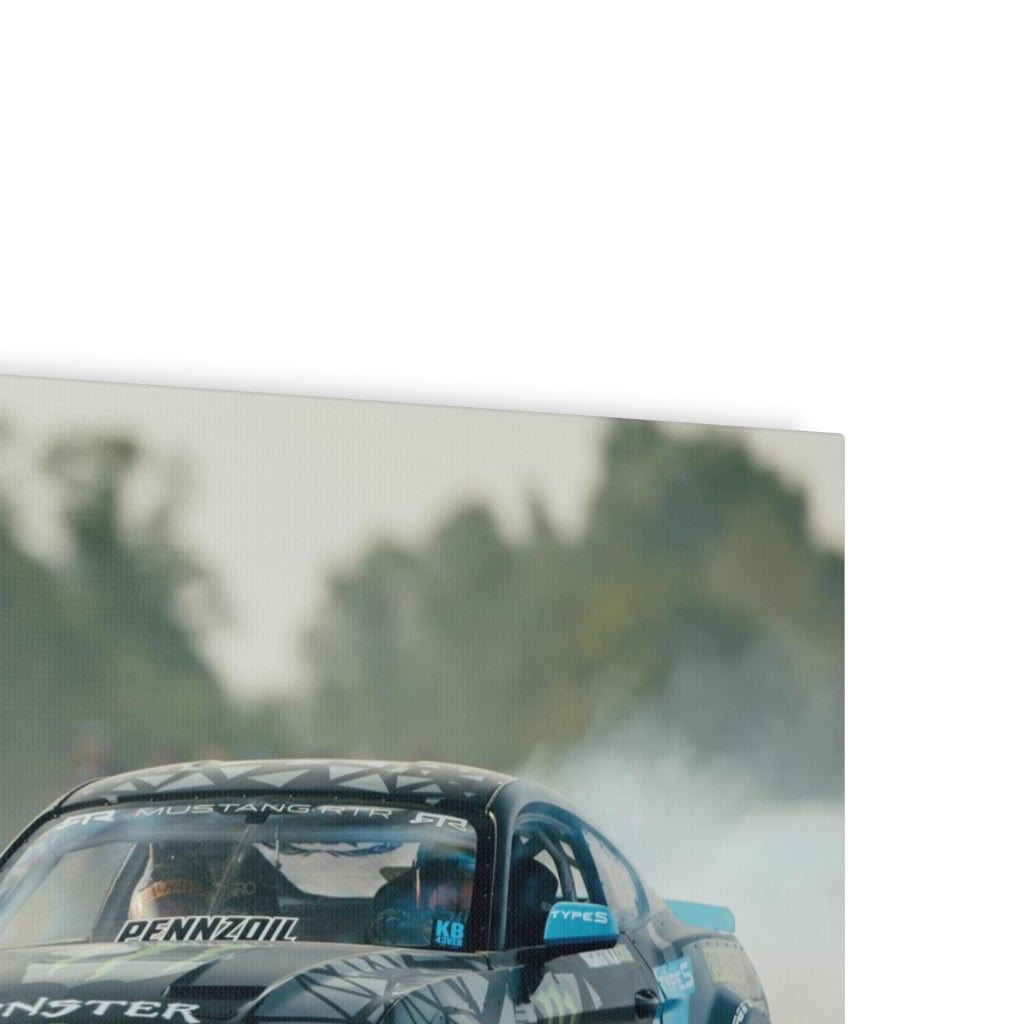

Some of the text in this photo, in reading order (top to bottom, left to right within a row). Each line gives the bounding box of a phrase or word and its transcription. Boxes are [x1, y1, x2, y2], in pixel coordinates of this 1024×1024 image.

[136, 803, 393, 820] MUSTANG RTR
[114, 914, 300, 944] PENNZOIL
[435, 919, 465, 939] KB
